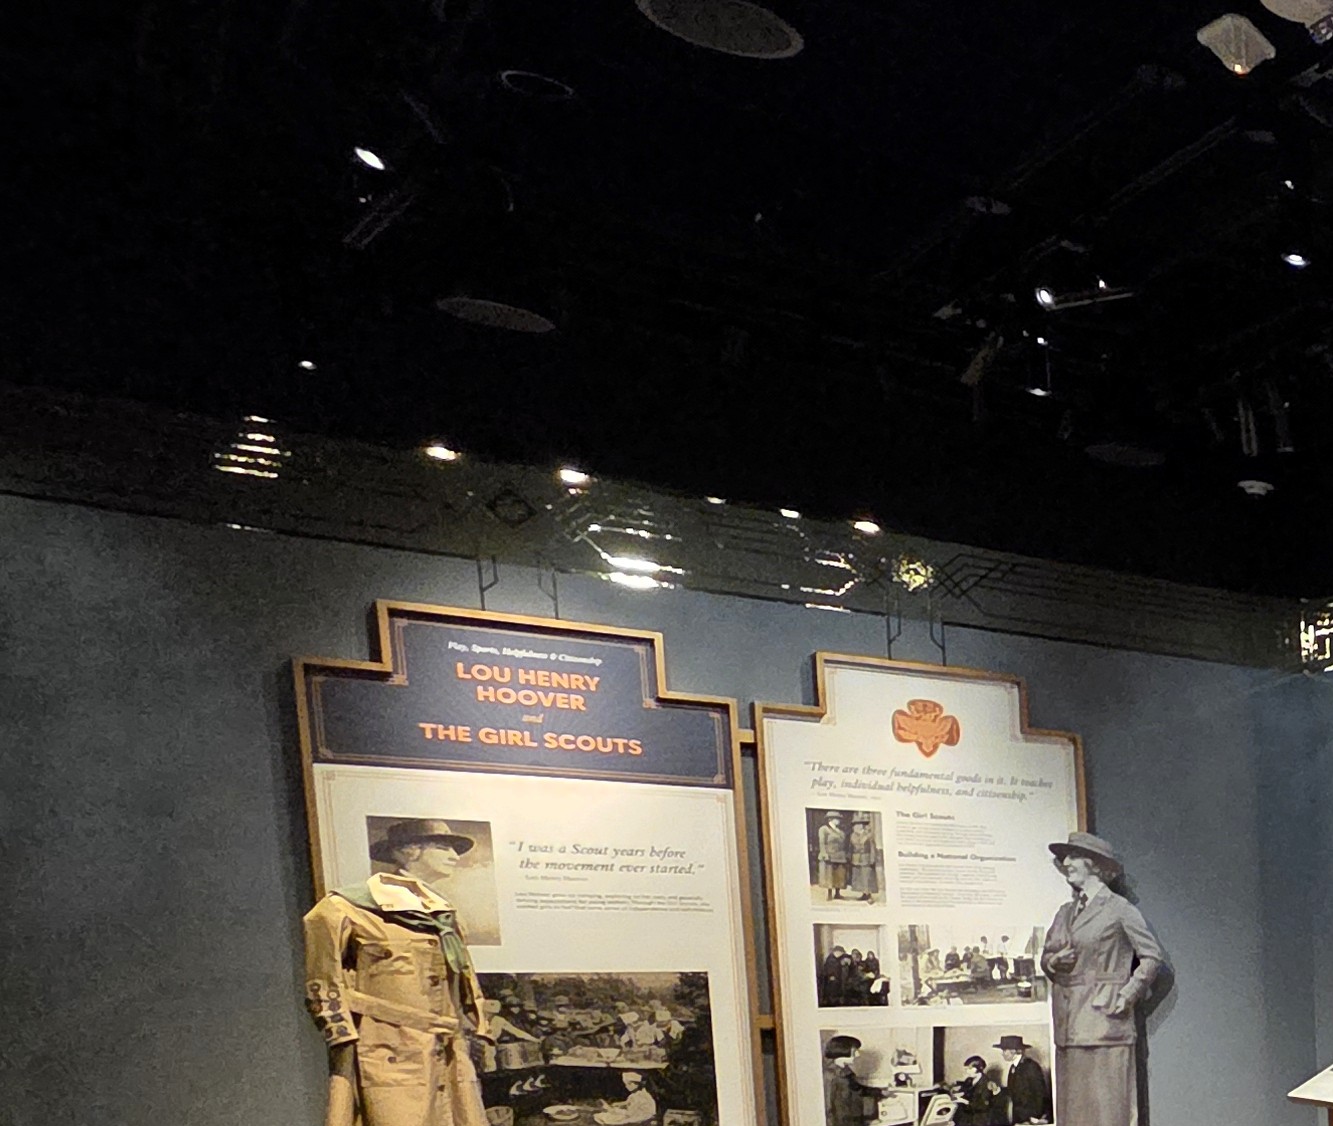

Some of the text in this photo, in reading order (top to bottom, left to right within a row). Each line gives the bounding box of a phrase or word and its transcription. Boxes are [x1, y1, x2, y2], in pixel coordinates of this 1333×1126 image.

[456, 662, 600, 691] LOU HENRY
[476, 686, 586, 711] HOOVER
[418, 723, 643, 755] THE GIRL SCOUTS
[528, 844, 553, 853] was
[559, 845, 567, 854] a
[572, 844, 608, 856] Scout
[611, 847, 644, 859] years
[649, 846, 686, 859] before
[519, 858, 541, 869] the
[545, 861, 614, 872] movement
[618, 863, 646, 873] ever
